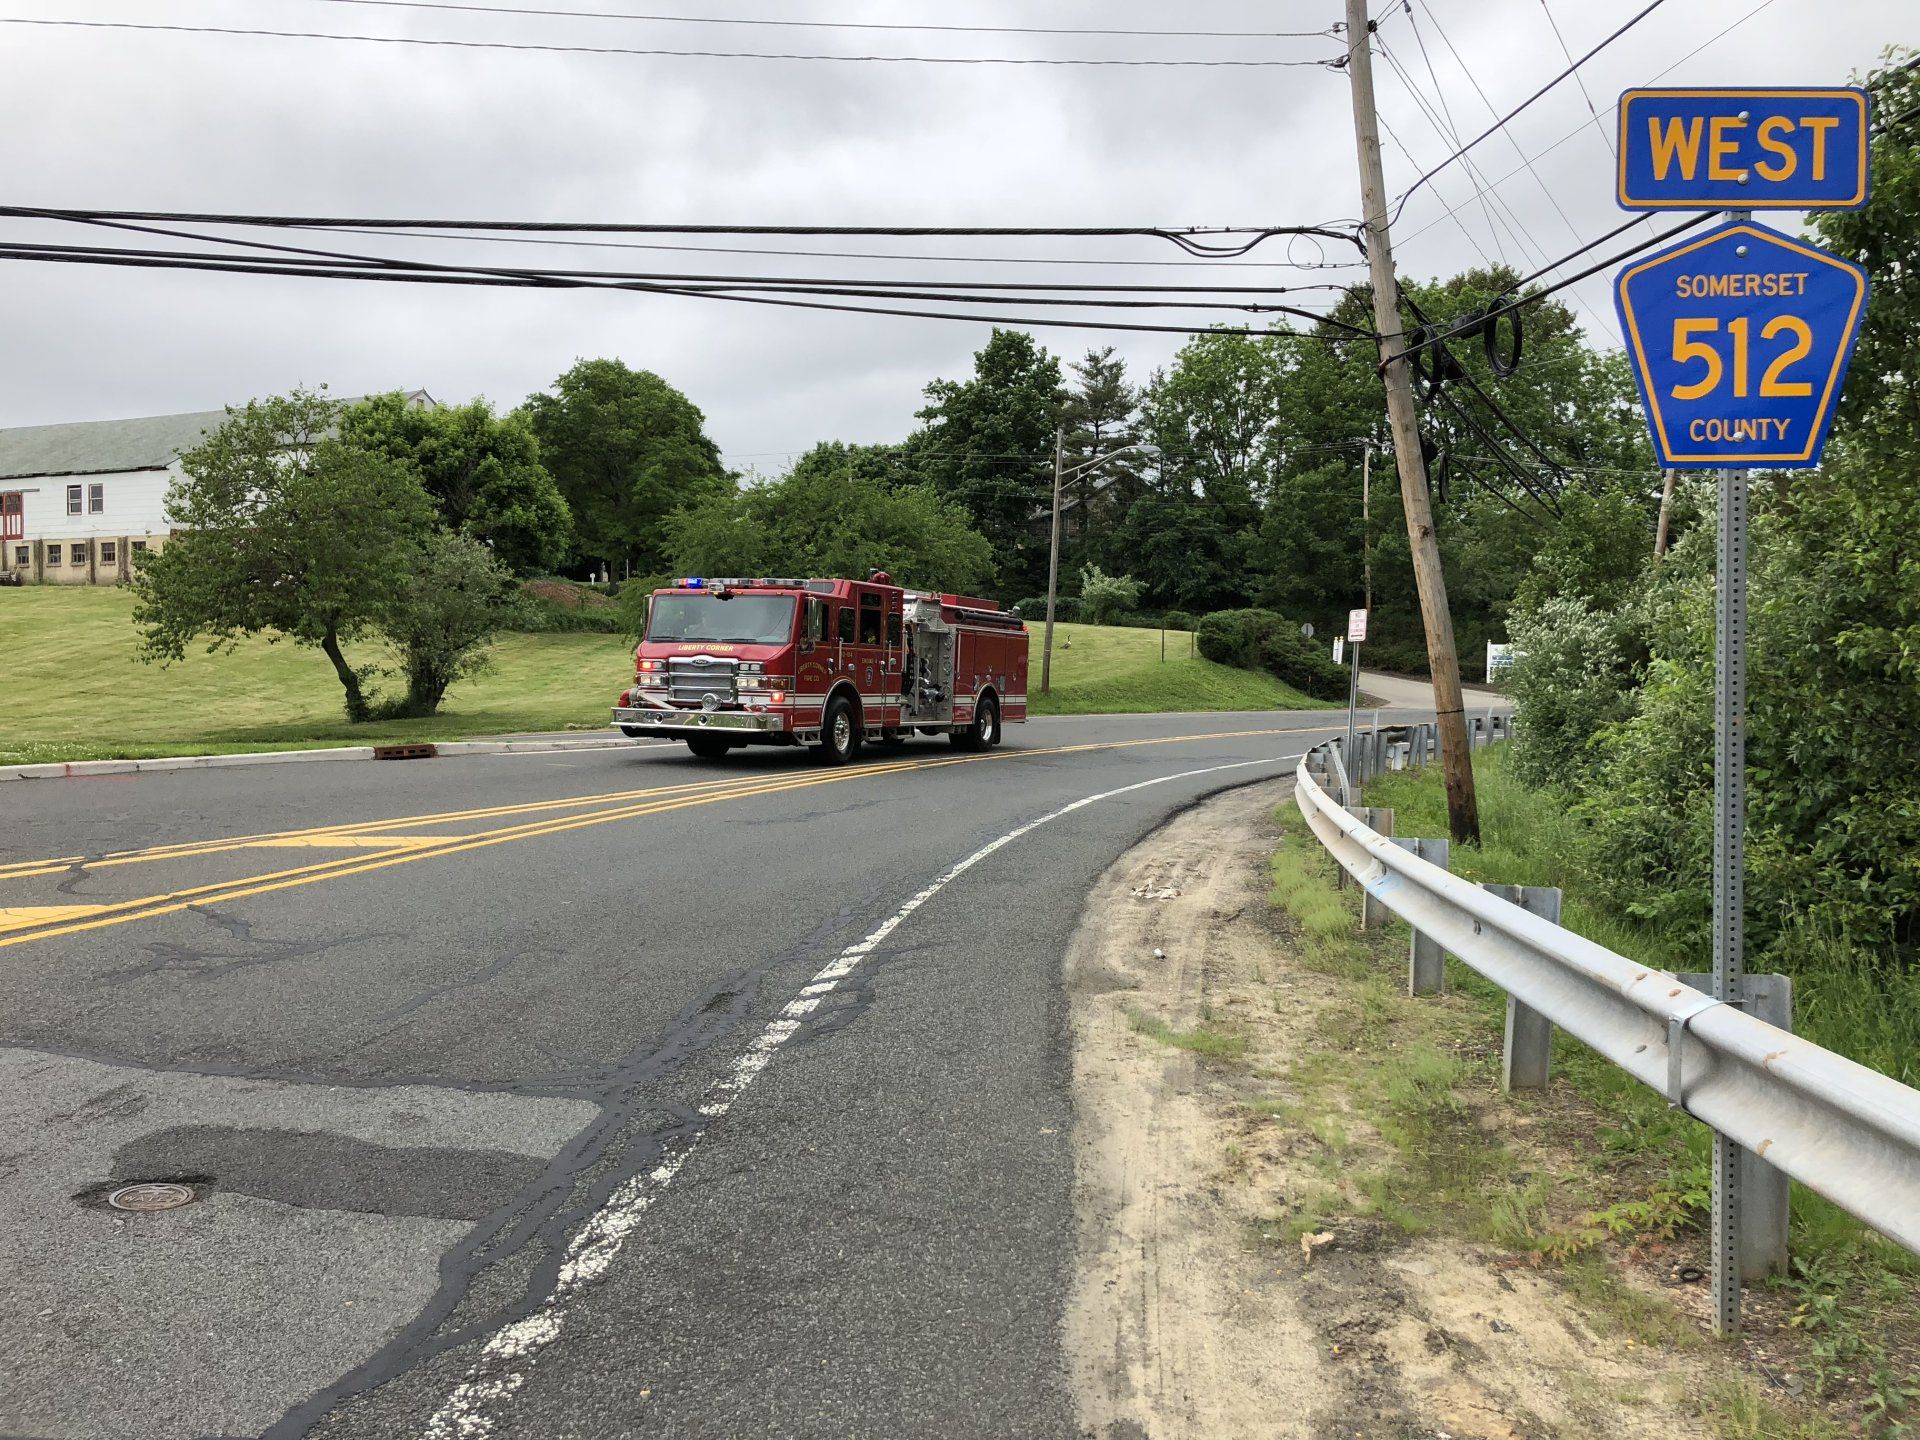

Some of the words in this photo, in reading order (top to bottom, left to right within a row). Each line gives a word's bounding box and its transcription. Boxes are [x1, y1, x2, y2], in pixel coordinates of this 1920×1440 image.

[1648, 115, 1839, 182] WEST
[1676, 272, 1809, 298] SOMERSET
[1670, 314, 1813, 400] 512
[1689, 418, 1792, 443] COUNTY
[124, 1194, 181, 1203] WATER
